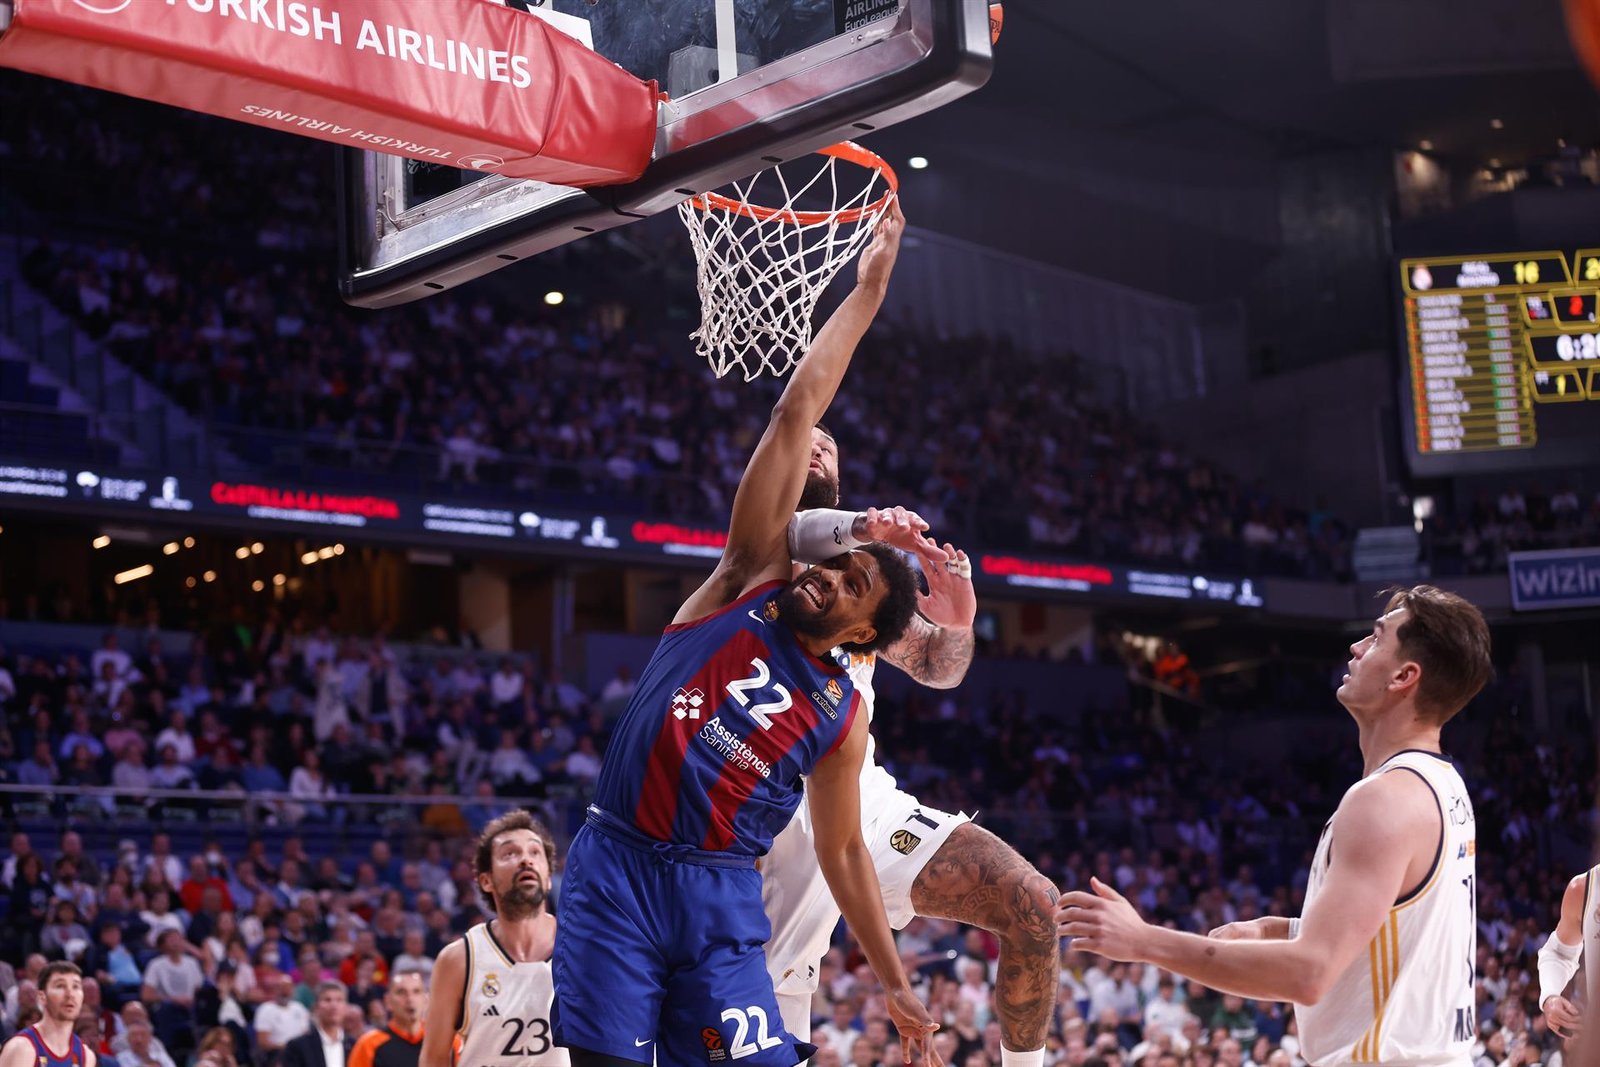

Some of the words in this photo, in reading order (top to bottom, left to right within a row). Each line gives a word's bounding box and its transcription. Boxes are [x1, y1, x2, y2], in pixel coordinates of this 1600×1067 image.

[165, 0, 343, 45] RKISH
[356, 19, 532, 89] AIRLINES
[240, 105, 351, 134] AIRLINES
[350, 130, 452, 159] TURKISH
[725, 657, 793, 731] 22
[707, 716, 771, 778] Assistència
[500, 1017, 550, 1056] 23
[720, 1005, 784, 1060] 22
